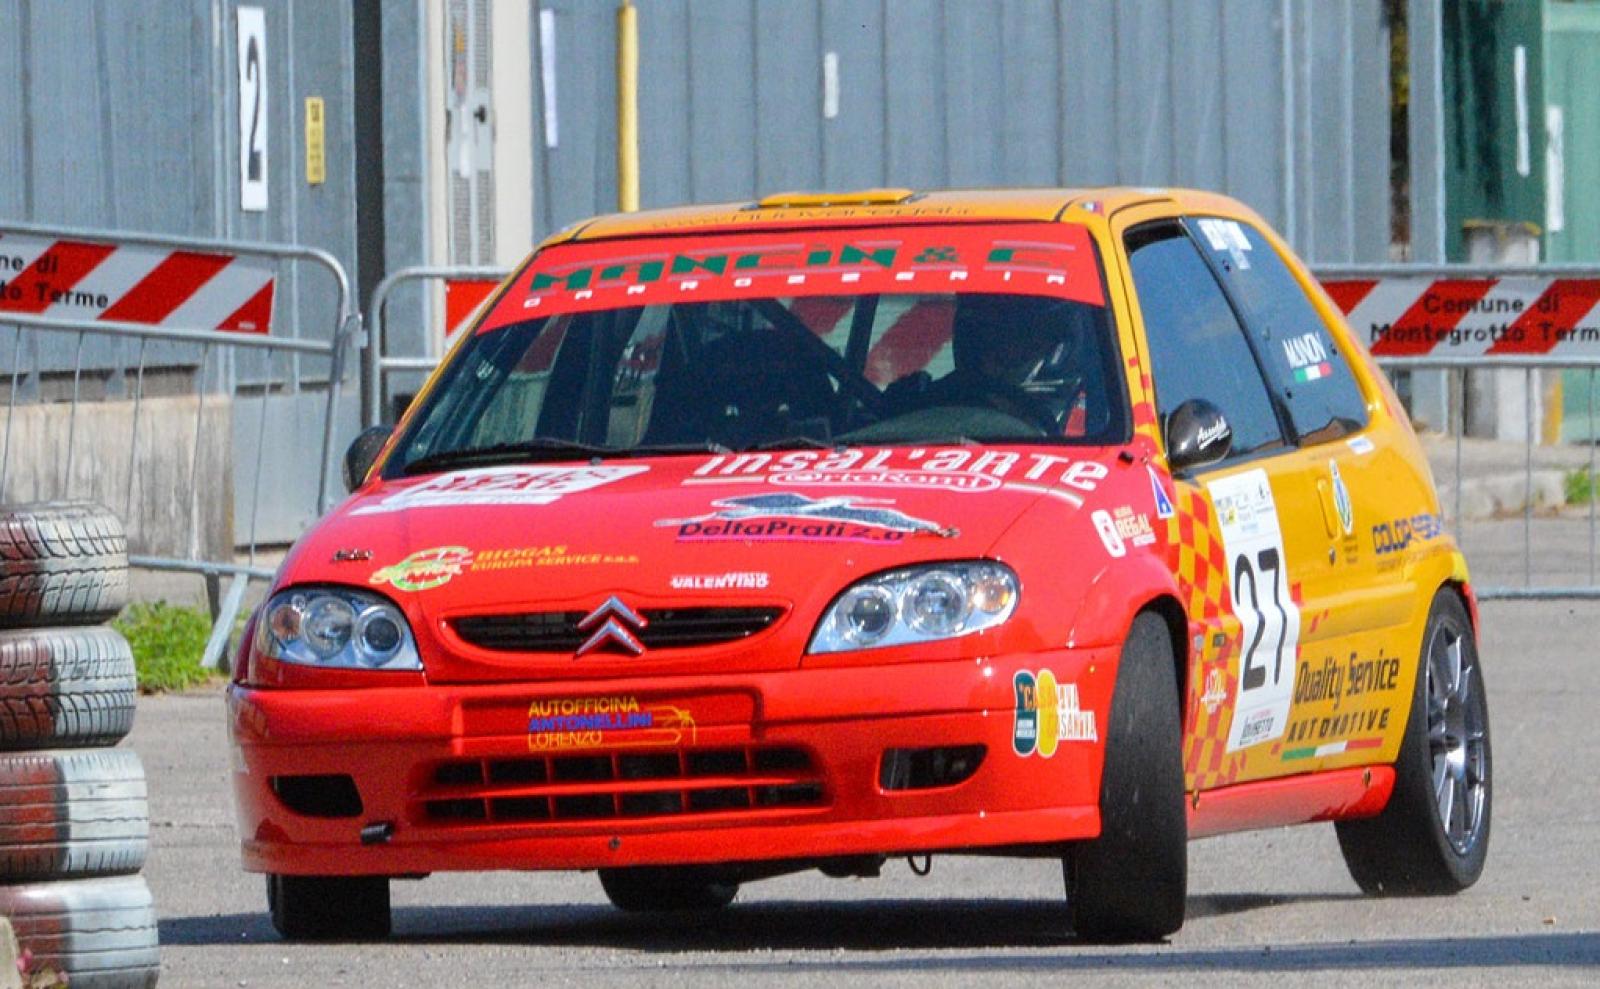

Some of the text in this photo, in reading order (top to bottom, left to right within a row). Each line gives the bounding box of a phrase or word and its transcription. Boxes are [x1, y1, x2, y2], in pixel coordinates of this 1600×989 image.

[247, 35, 261, 181] 2
[36, 250, 59, 274] di
[35, 281, 109, 309] Terme
[1423, 293, 1560, 314] Comune di
[1370, 322, 1525, 346] Montegrotto
[678, 519, 848, 538] DeltaPrati
[1234, 548, 1287, 692] 27
[1294, 648, 1400, 711] Quality Service
[529, 696, 640, 716] AUTOFFICINA
[1287, 707, 1391, 743] AUTOMOTIVE
[529, 730, 602, 748] LORENZO
